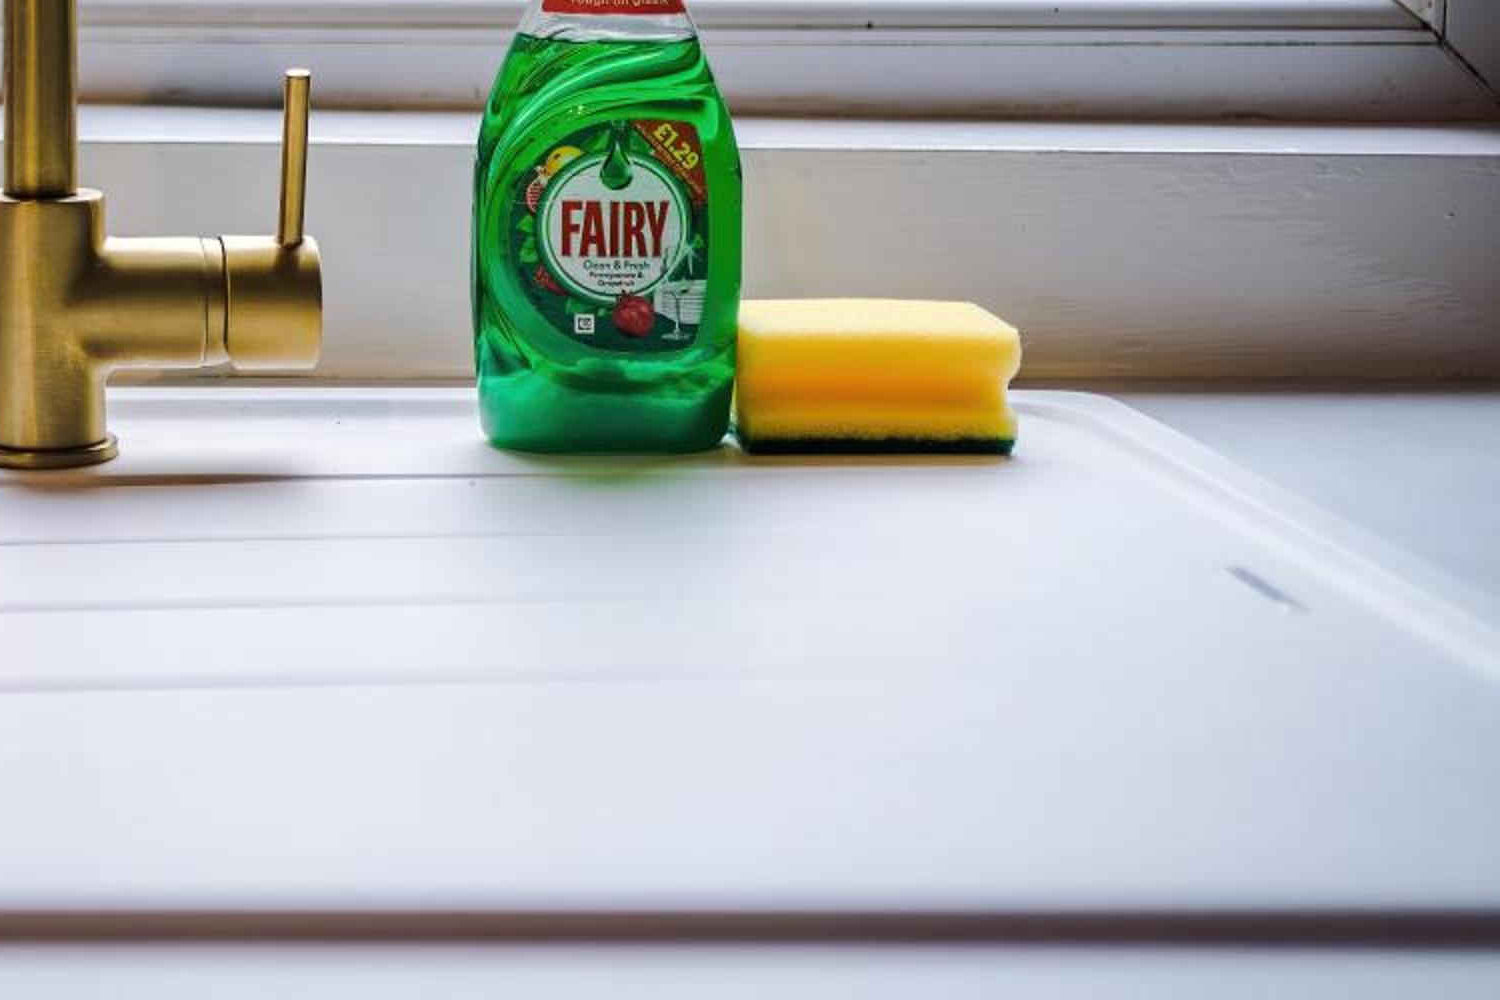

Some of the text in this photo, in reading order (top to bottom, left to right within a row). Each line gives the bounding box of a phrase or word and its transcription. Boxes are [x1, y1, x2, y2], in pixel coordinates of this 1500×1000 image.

[653, 123, 699, 169] £1.29
[560, 200, 671, 258] FAIRY
[613, 260, 621, 270] &
[623, 260, 651, 270] Fresh
